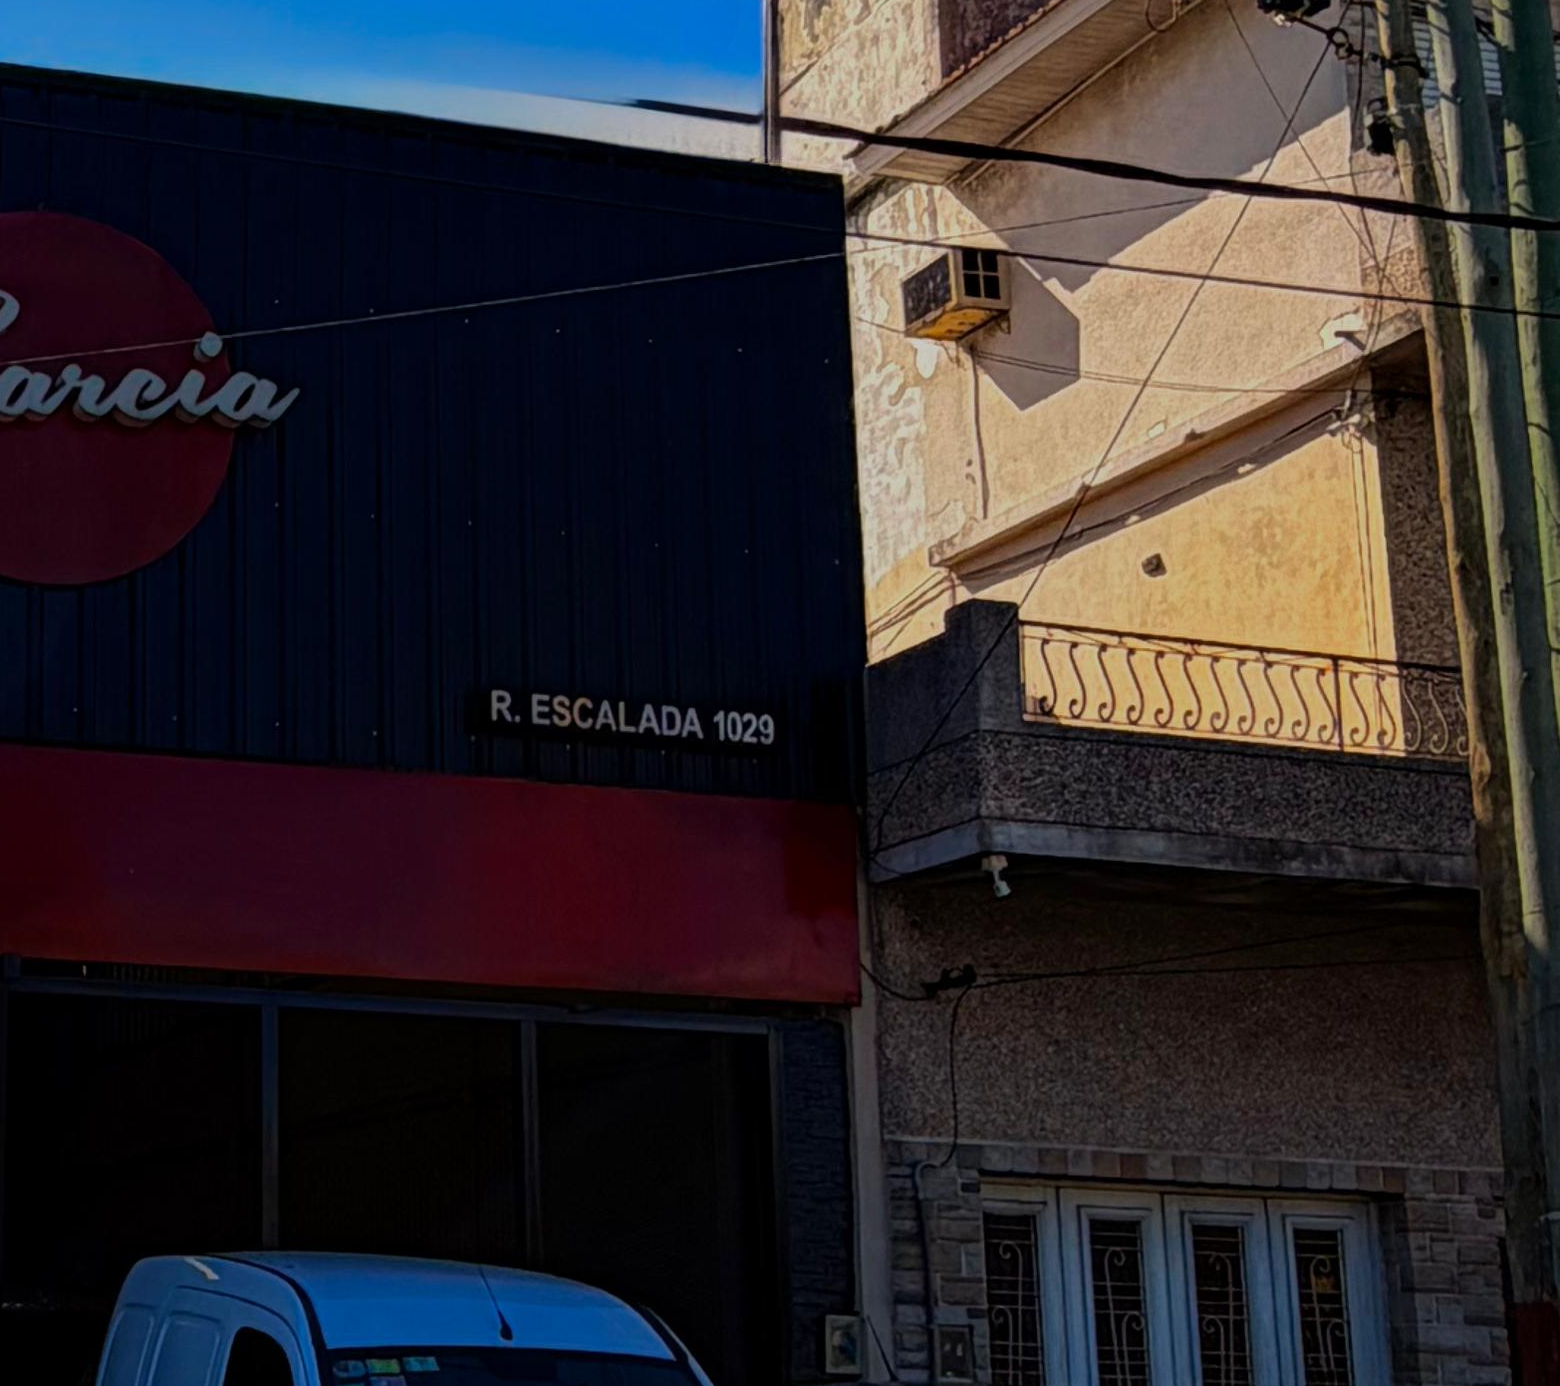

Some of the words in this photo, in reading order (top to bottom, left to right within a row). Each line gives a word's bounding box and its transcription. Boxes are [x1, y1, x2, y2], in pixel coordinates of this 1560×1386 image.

[490, 689, 521, 723] R.
[531, 693, 704, 740] ESCALADA
[712, 709, 775, 745] 1029
